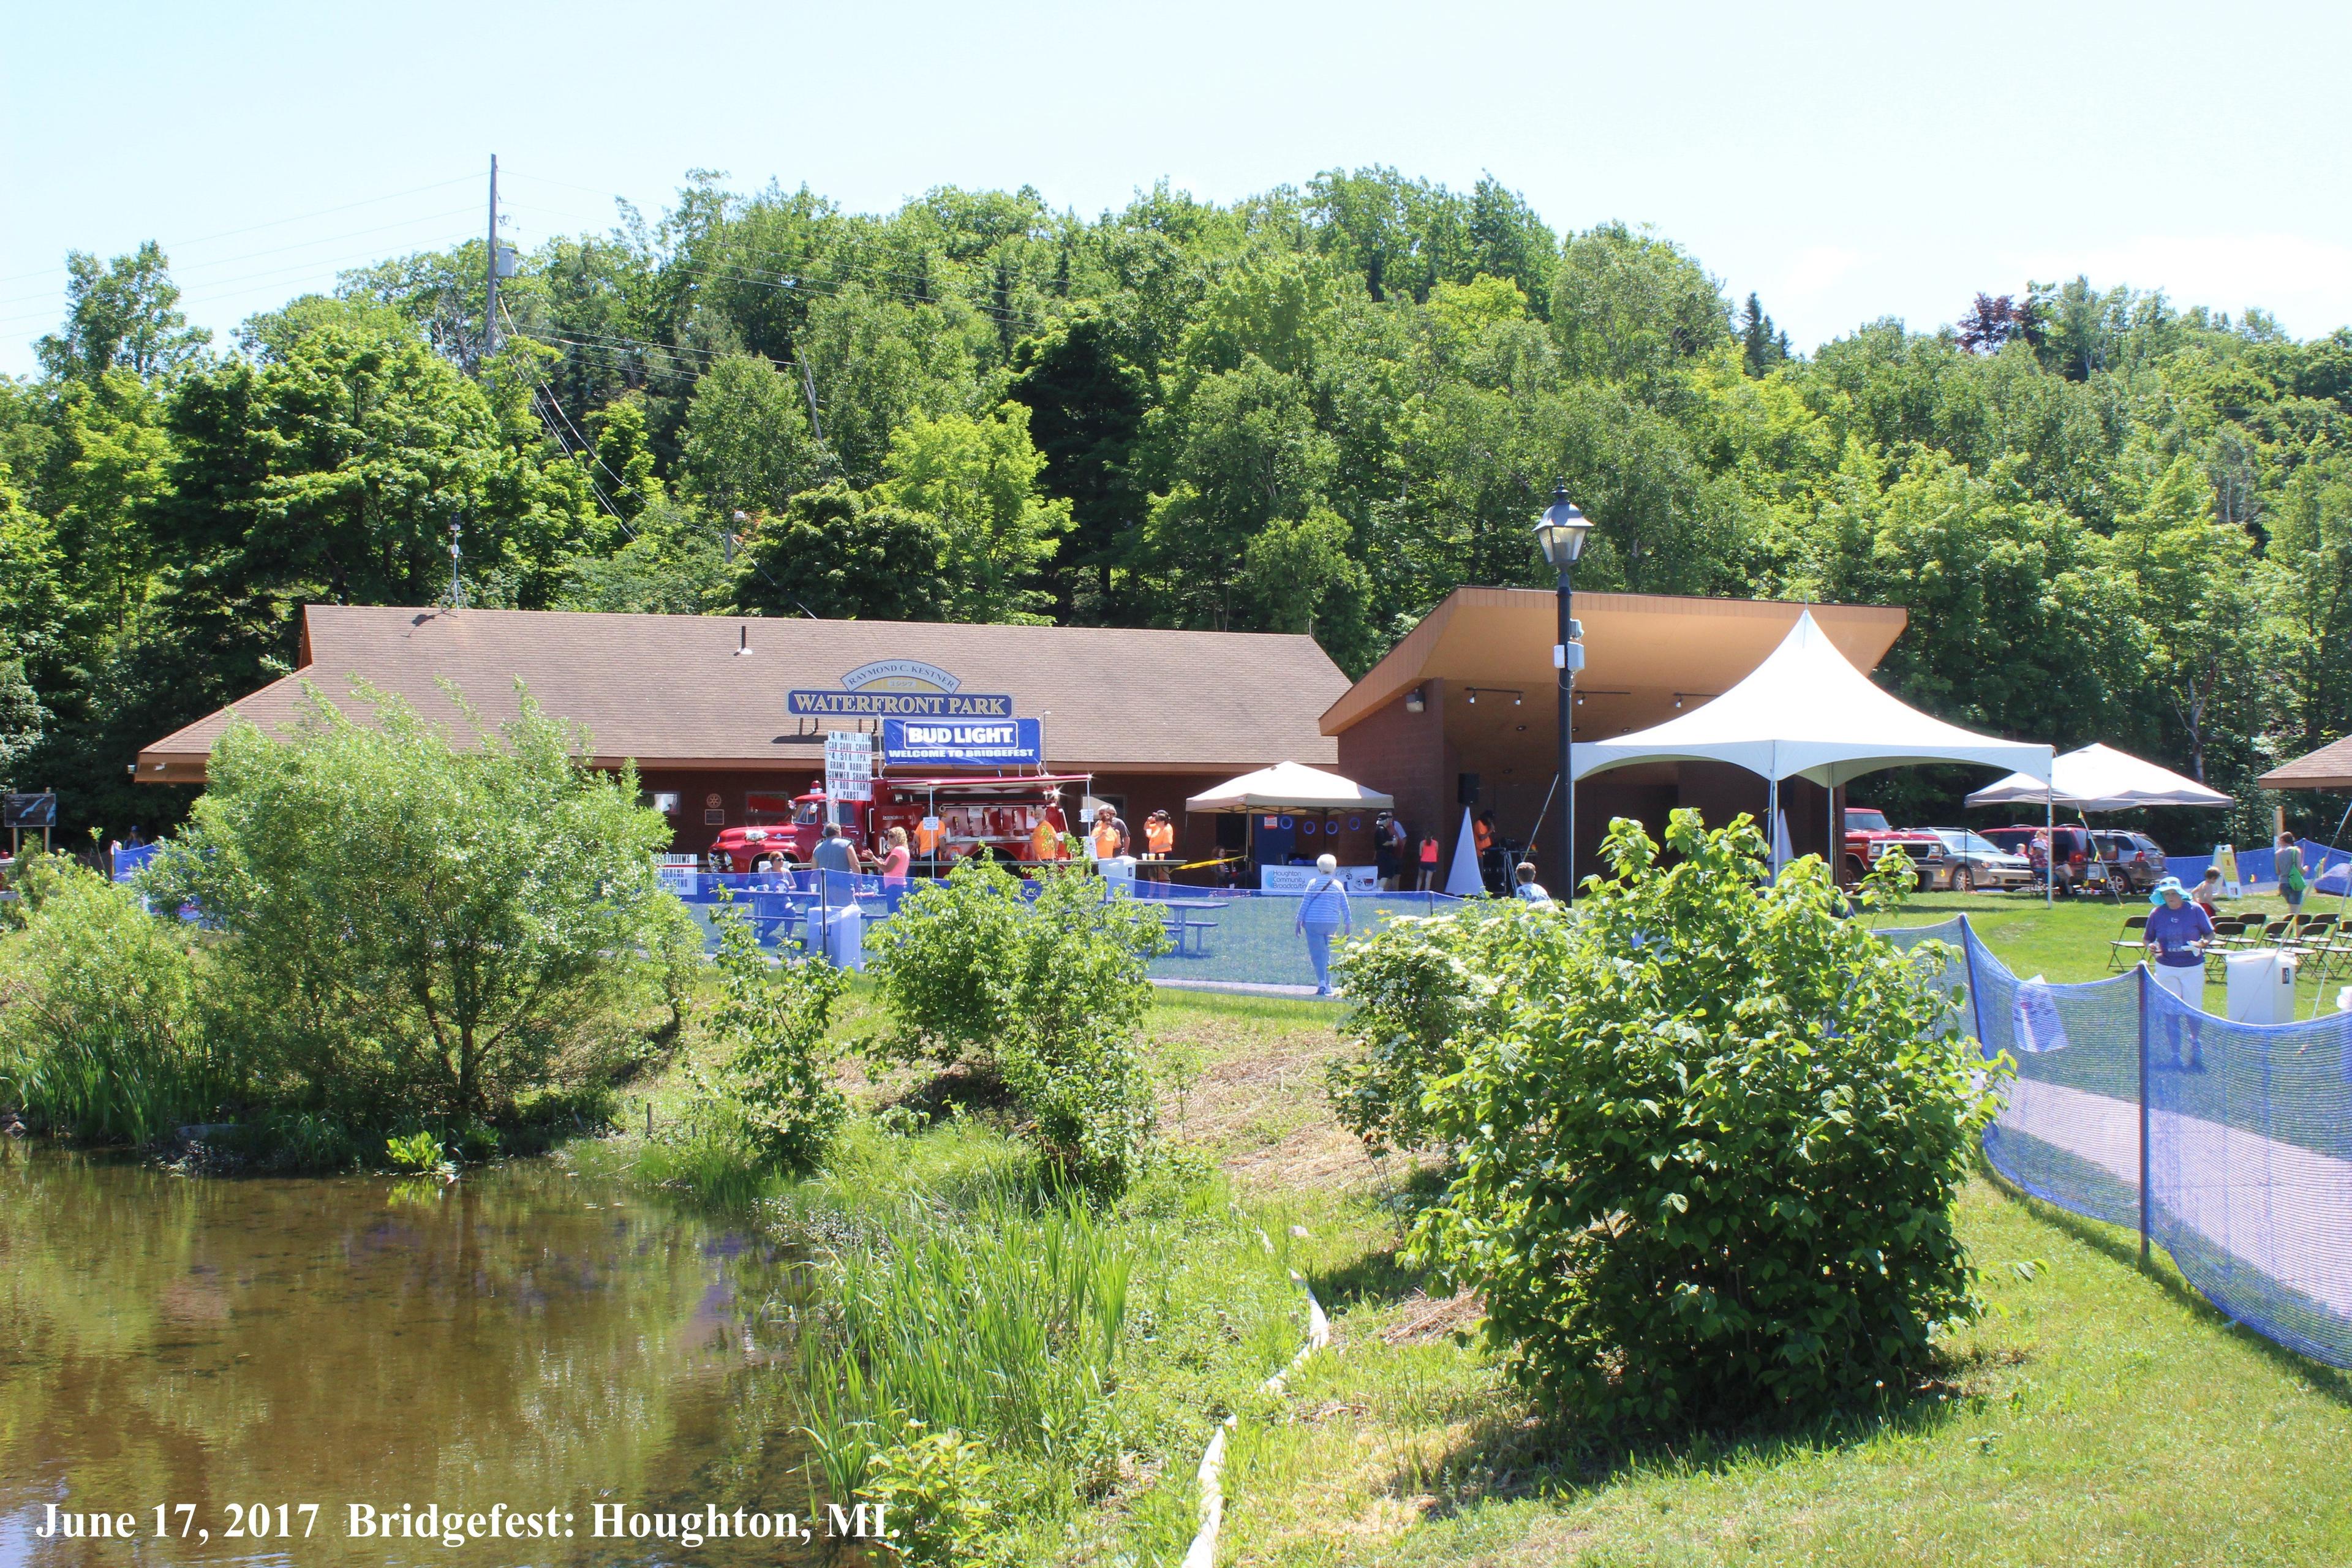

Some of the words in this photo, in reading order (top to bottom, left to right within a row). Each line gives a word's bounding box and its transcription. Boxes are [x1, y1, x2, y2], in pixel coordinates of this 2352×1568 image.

[848, 665, 897, 685] RAYMOND
[911, 666, 955, 688] KESTNER
[793, 693, 944, 714] WATERFRONT
[948, 697, 1006, 715] PARK
[840, 733, 856, 741] WHITE
[908, 727, 952, 743] BUD
[828, 741, 837, 750] CAB
[840, 742, 852, 751] SAUV
[888, 749, 946, 758] WELCOME
[830, 761, 845, 769] GRAND
[850, 763, 872, 772] RABBITS
[828, 771, 850, 779] SUMMER
[853, 772, 872, 782] SHANDY
[840, 781, 849, 790] BUD
[853, 782, 869, 791] LIGHT
[843, 791, 859, 799] PABST
[663, 854, 690, 864] STROOMS
[662, 869, 684, 878] BEHIND
